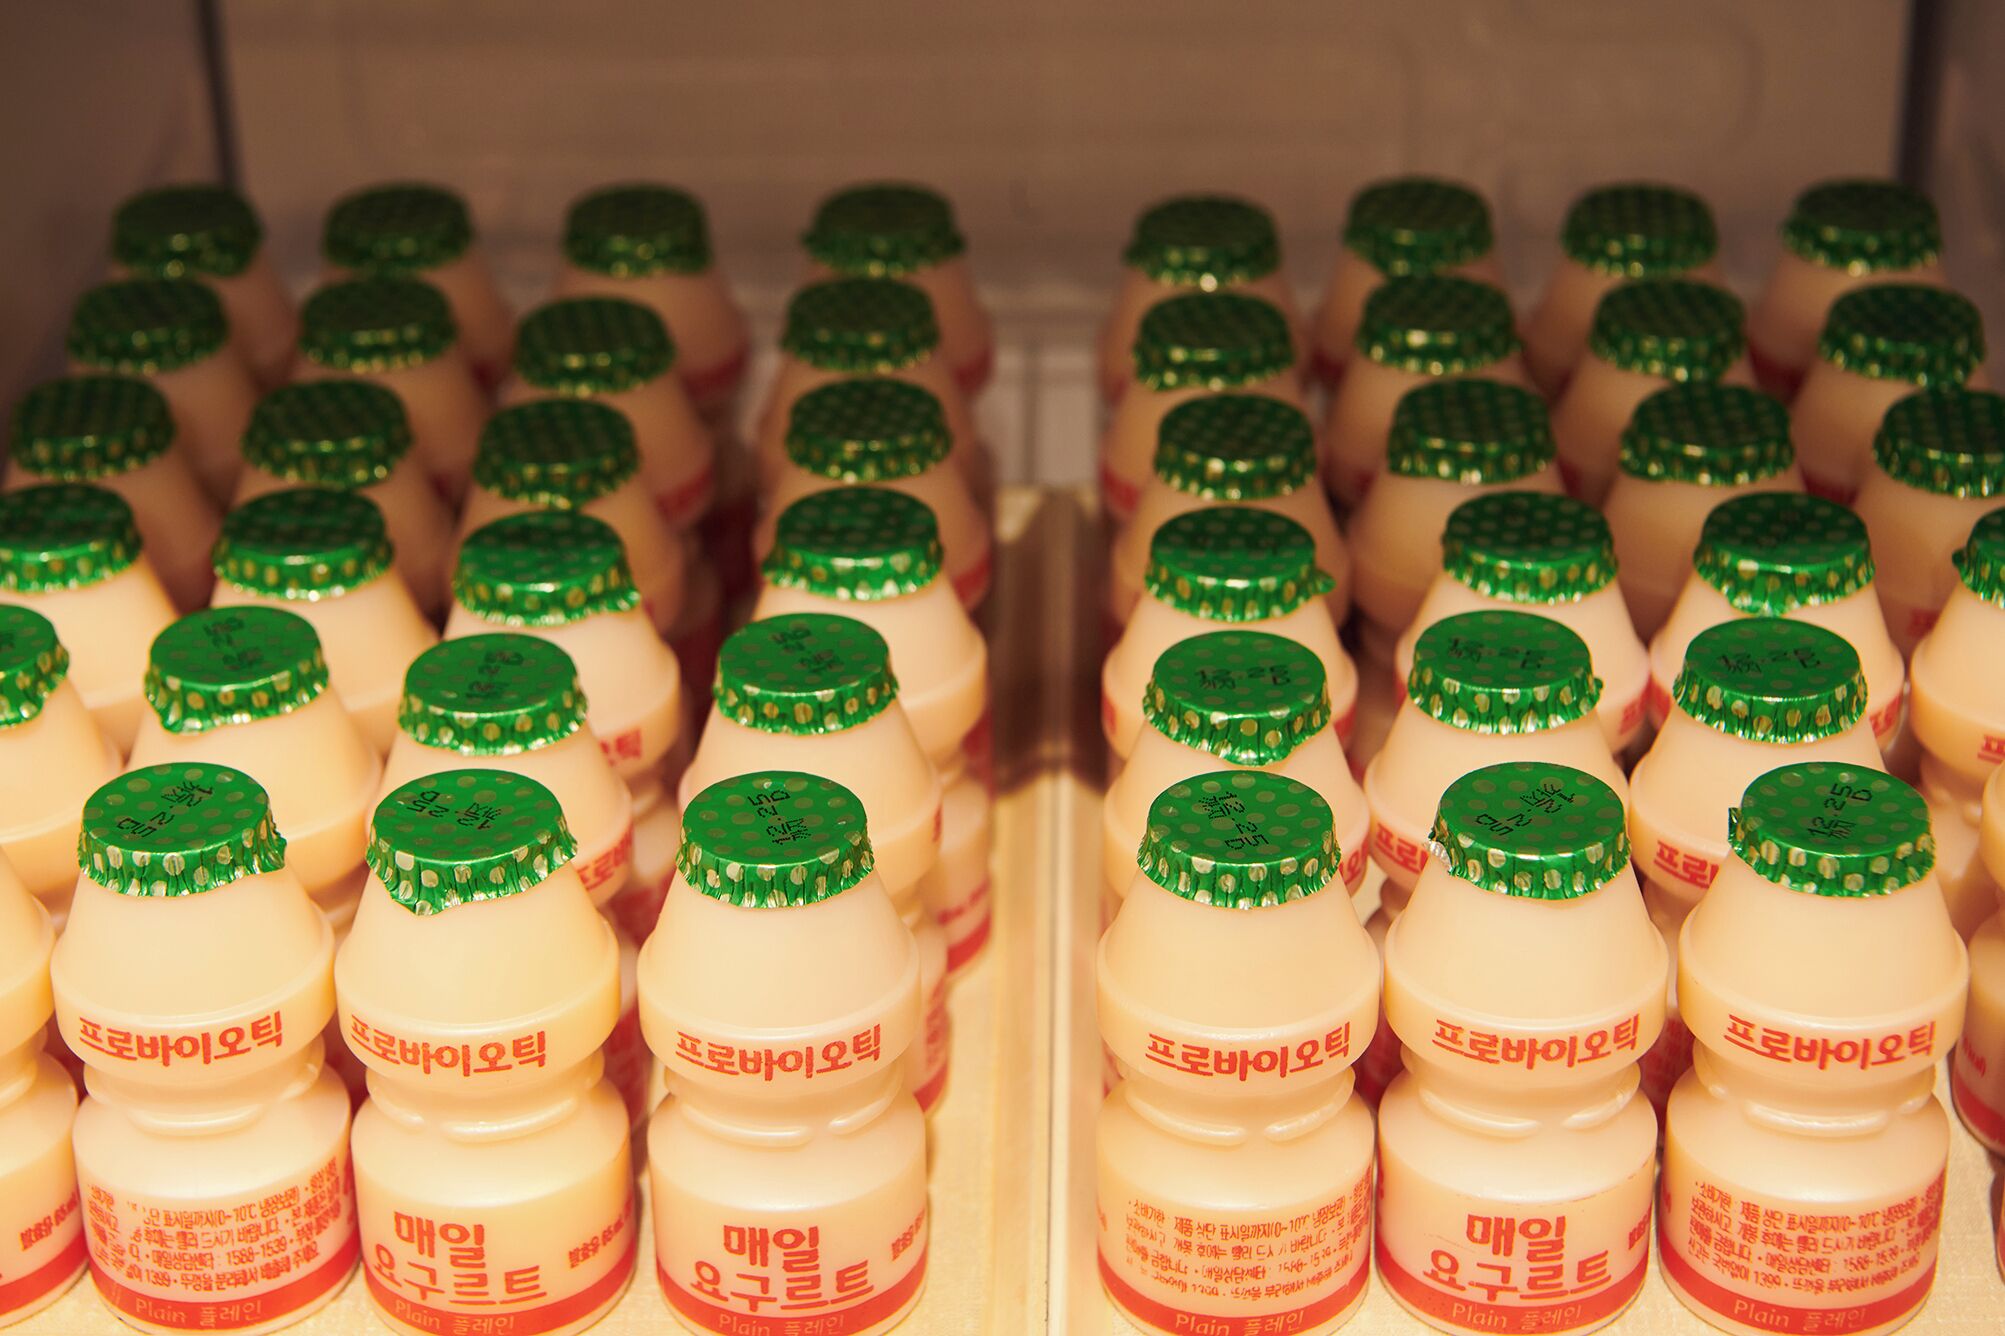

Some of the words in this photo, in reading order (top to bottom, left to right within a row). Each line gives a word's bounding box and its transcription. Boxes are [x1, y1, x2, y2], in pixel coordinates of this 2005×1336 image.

[79, 1010, 283, 1067] 프로바이오틱
[351, 1014, 546, 1077] 프로바이오틱
[675, 1023, 881, 1082] 프로바이오틱
[1145, 1021, 1350, 1082] 프로바이오틱
[1432, 1013, 1639, 1070] 프로바이오틱
[1723, 1014, 1936, 1070] 프로바이오틱
[394, 1211, 486, 1269] 매일
[723, 1225, 820, 1273] 매일
[1466, 1214, 1566, 1263] 매일
[373, 1243, 547, 1305] 요구르트
[690, 1259, 874, 1312] 요구르트
[1422, 1249, 1612, 1302] 요구르트
[135, 1299, 187, 1325] Plain
[199, 1300, 262, 1328] 플레인
[394, 1300, 441, 1330] Plain
[453, 1315, 515, 1335] 플레인
[719, 1313, 771, 1335] Plain
[783, 1314, 844, 1336] 플레인
[1175, 1313, 1230, 1336] Plain
[1244, 1310, 1304, 1336] 플레인
[1453, 1302, 1508, 1329] Plain
[1520, 1304, 1582, 1330] 플레인
[1733, 1299, 1790, 1328] Plain
[1803, 1308, 1867, 1333] 플레인
